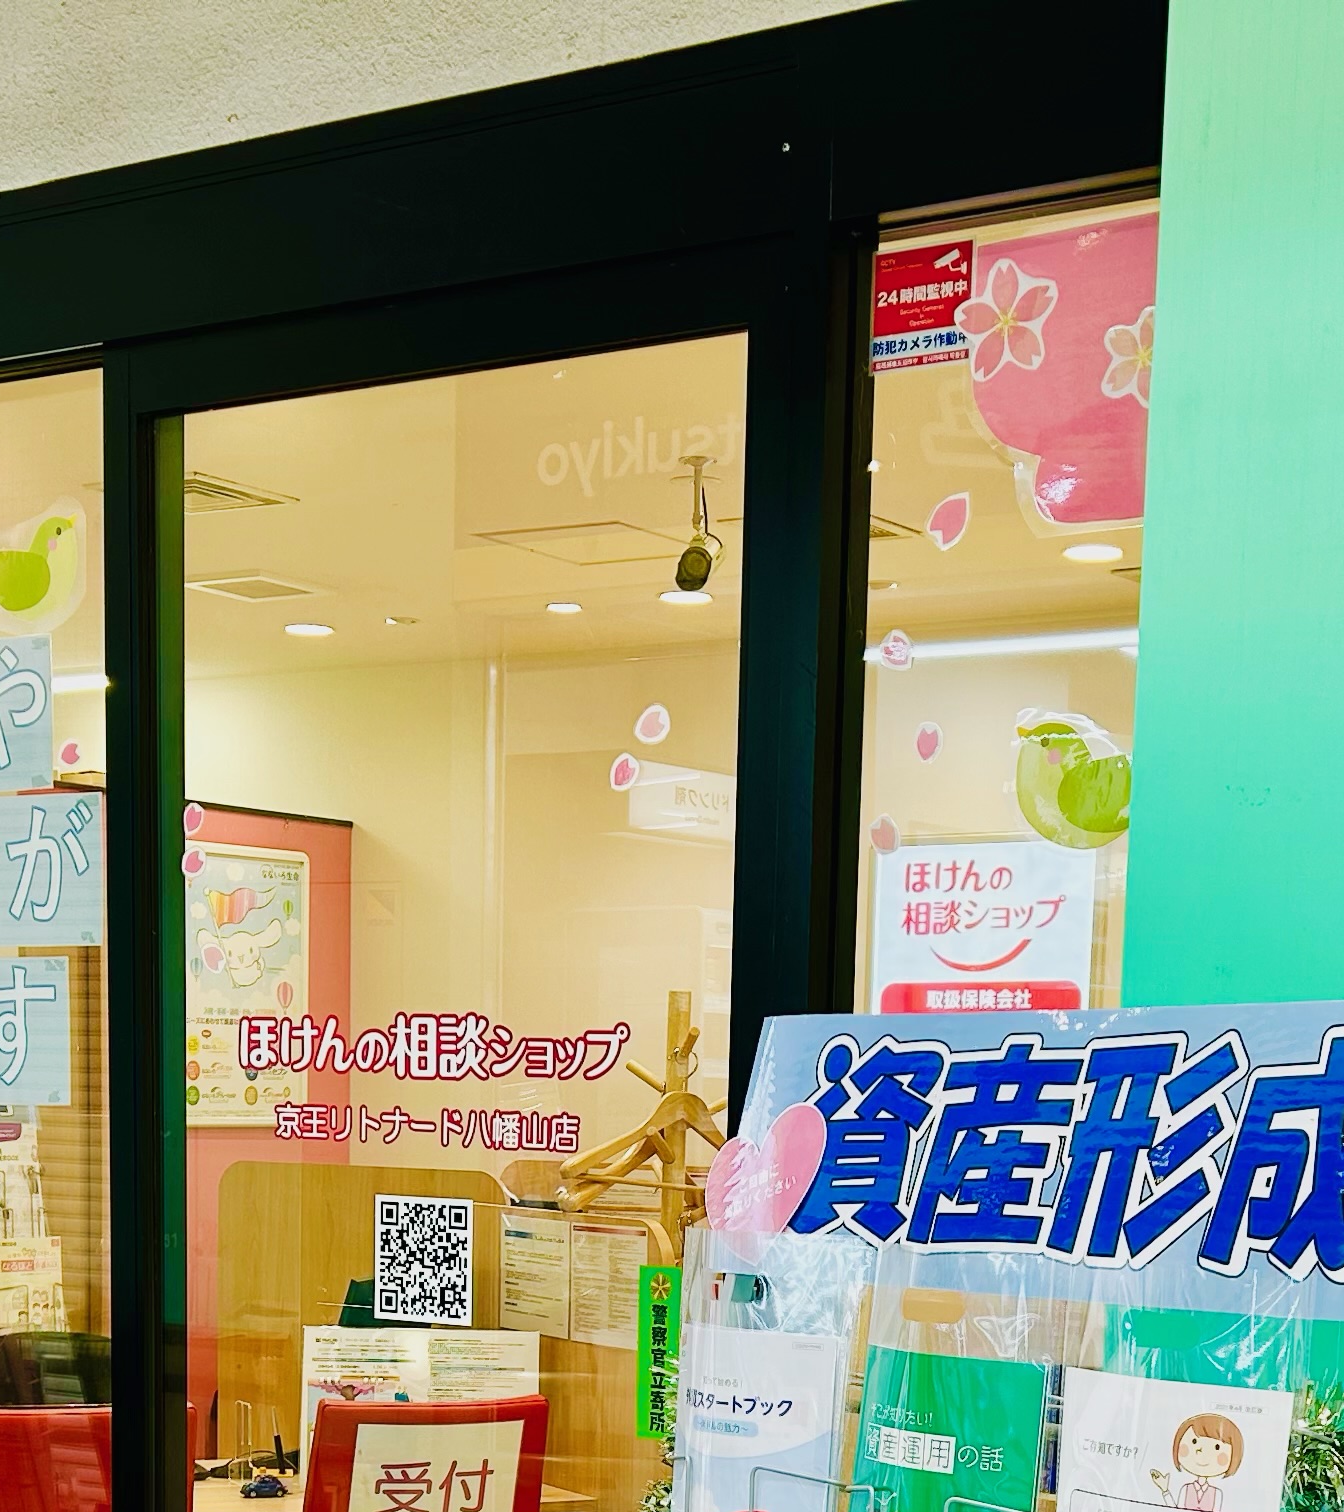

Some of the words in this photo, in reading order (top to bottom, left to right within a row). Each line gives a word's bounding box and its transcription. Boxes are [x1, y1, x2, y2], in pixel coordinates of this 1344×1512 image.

[877, 279, 968, 308] 24時間監視中
[905, 860, 1012, 893] ほけんの
[901, 894, 1067, 935] 相談ショップ
[926, 988, 1033, 1010] 取扱保険会社
[238, 1011, 630, 1081] ほけんの相談ショップ
[274, 1102, 580, 1153] 京王リトナード八幡山店
[649, 1304, 668, 1432] 警察官立寄所
[866, 1423, 1004, 1473] 資産運用の話
